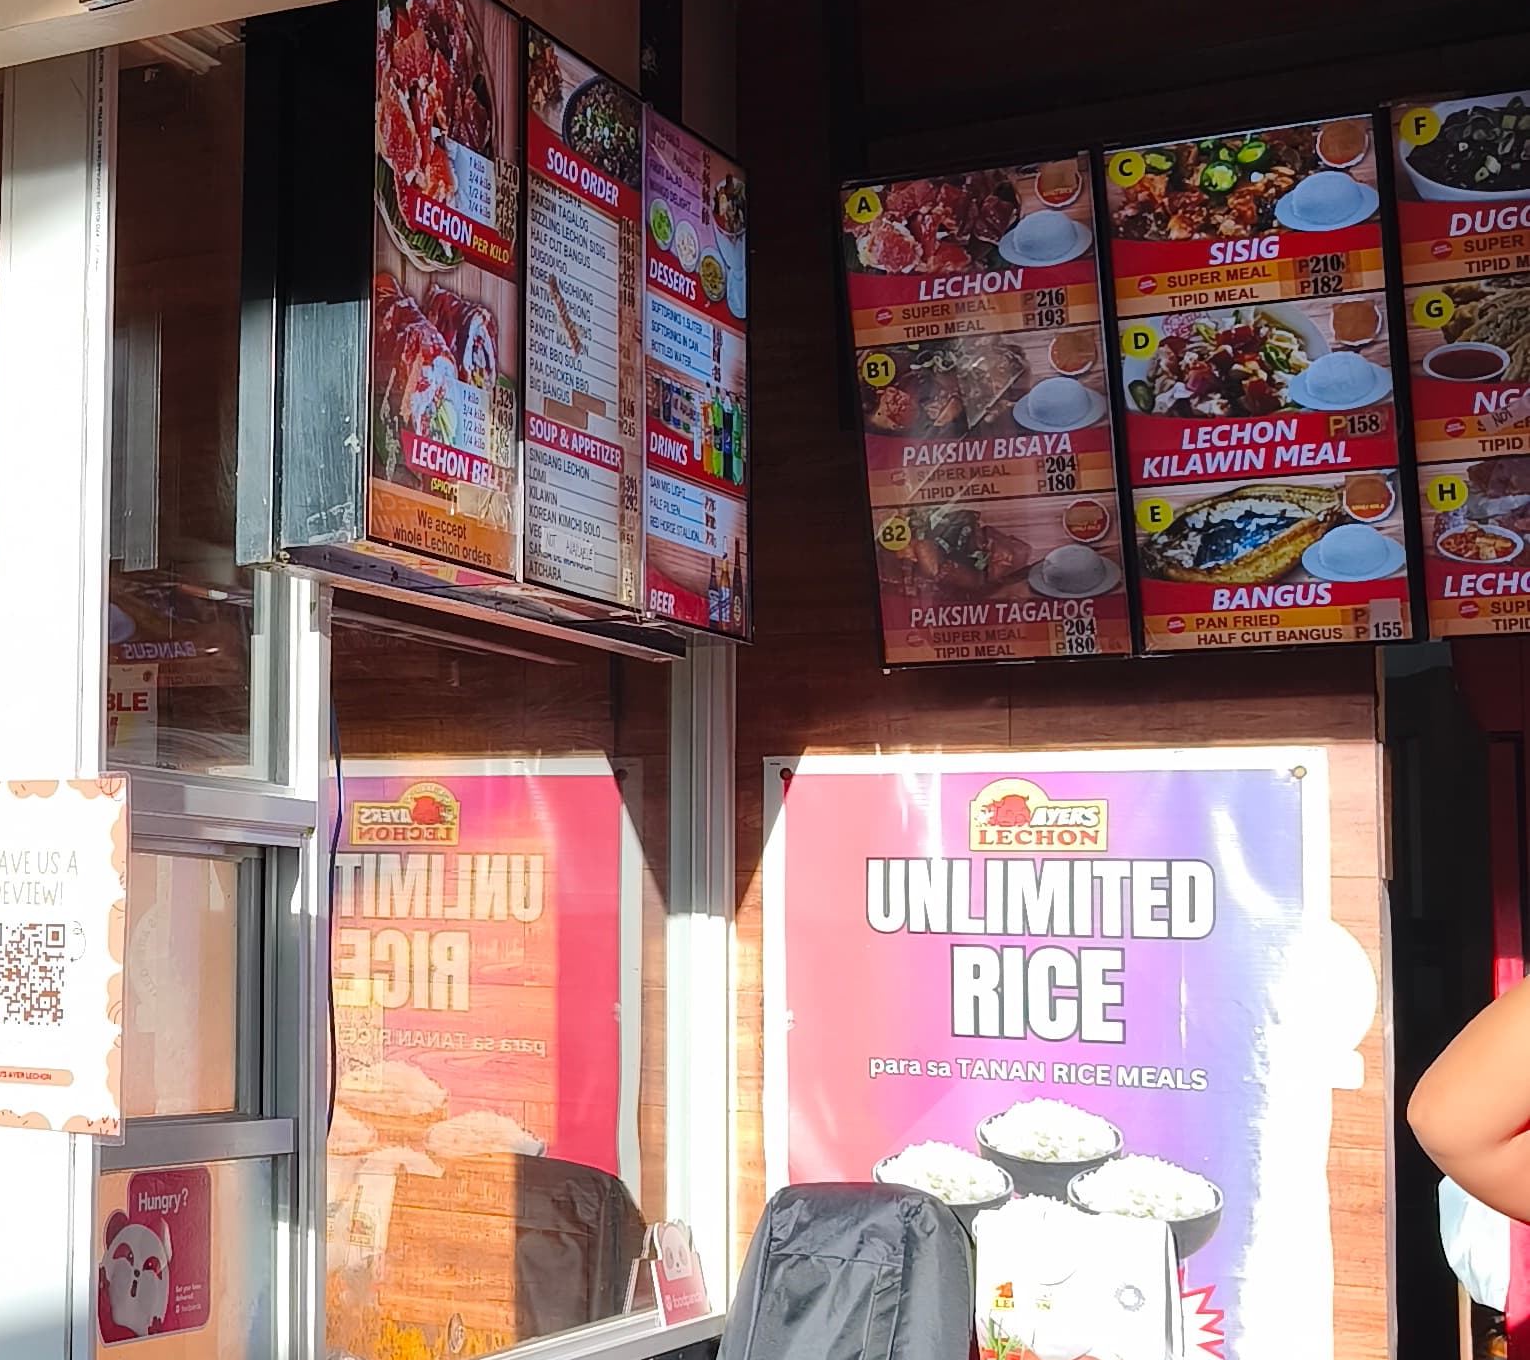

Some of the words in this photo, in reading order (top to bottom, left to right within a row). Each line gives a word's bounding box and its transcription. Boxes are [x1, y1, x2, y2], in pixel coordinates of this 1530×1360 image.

[1414, 117, 1427, 136] F
[547, 147, 579, 183] SOLO
[581, 167, 619, 207] ORDER
[1119, 158, 1132, 176] C
[857, 197, 872, 213] A
[415, 197, 472, 247] LECHON
[472, 234, 488, 255] PER
[490, 243, 510, 264] KILO
[531, 208, 561, 231] SIZZLING
[561, 224, 588, 249] LECHON
[589, 240, 606, 259] SISIG
[530, 226, 548, 245] HALF
[549, 237, 562, 253] CUT
[563, 243, 591, 268] BANGUS
[1209, 236, 1280, 265] SISIG
[1464, 234, 1524, 253] SUPER
[1167, 270, 1221, 288] SUPER
[1226, 266, 1272, 282] MEAL
[1465, 258, 1510, 274] TIPID
[650, 258, 697, 300] DESSERTS
[919, 269, 1024, 301] LECHON
[1168, 293, 1209, 308] TIPID
[1214, 287, 1259, 303] MEAL
[902, 303, 950, 320] SUPER
[954, 298, 996, 314] MEAL
[1425, 300, 1444, 319] G
[904, 323, 940, 338] TIPID
[945, 319, 985, 334] MEAL
[1133, 332, 1150, 350] D
[545, 363, 574, 387] CHICKEN
[867, 361, 889, 378] B1
[468, 392, 479, 404] kilo
[492, 387, 514, 409] 1,329
[530, 376, 541, 391] BIG
[543, 381, 570, 403] BANGUS
[463, 405, 473, 419] 3/4
[474, 409, 485, 421] kilo
[463, 420, 473, 432] 1/2
[474, 423, 485, 436] kilo
[1182, 418, 1298, 450] LECHON
[463, 434, 472, 446] 1/4
[474, 437, 485, 449] kilo
[530, 417, 558, 442] SOUP
[560, 428, 569, 449] &
[571, 433, 621, 467] APPETIZER
[650, 433, 687, 465] DRINKS
[903, 440, 987, 466] PAKSIW
[993, 433, 1072, 459] BISAYA
[1478, 438, 1523, 452] TIPID
[412, 439, 470, 480] LECHON
[529, 448, 562, 472] SINIGANG
[564, 461, 590, 481] LECHON
[1142, 448, 1266, 479] KILAWIN
[1274, 441, 1352, 469] MEAL
[529, 467, 547, 483] LOMI
[918, 467, 966, 481] SUPER
[970, 464, 1010, 478] MEAL
[529, 486, 558, 506] KILAWIN
[920, 487, 955, 500] TIPID
[959, 483, 999, 496] MEAL
[1438, 483, 1456, 501] H
[417, 509, 433, 529] We
[435, 518, 467, 540] accept
[529, 504, 556, 523] KOREAN
[558, 512, 582, 532] KIMCHI
[583, 520, 601, 538] SOLO
[1150, 505, 1162, 523] E
[881, 525, 907, 541] B2
[392, 525, 422, 545] whole
[424, 534, 460, 555] Lechon
[462, 546, 492, 565] orders
[529, 561, 562, 582] ATCHARA
[650, 589, 675, 615] BEER
[1212, 582, 1332, 611] BANGUS
[910, 604, 989, 627] PAKSIW
[995, 599, 1094, 623] TAGALOG
[1195, 616, 1228, 629] PAN
[1233, 614, 1280, 628] FRIED
[933, 631, 983, 644] SUPER
[986, 629, 1027, 641] MEAL
[1197, 632, 1236, 646] HALF
[1241, 630, 1273, 644] CUT
[1276, 628, 1343, 642] BANGUS
[934, 646, 970, 659] TIPID
[975, 644, 1015, 657] MEAL
[1030, 806, 1100, 828] AYERS
[978, 829, 1100, 846] LECHON
[37, 850, 60, 874] US
[67, 850, 78, 876] A
[866, 858, 1215, 939] UNLIMITED
[950, 944, 1126, 1043] RICE
[869, 1056, 923, 1078] para
[926, 1059, 952, 1077] sa
[956, 1058, 1045, 1083] TANAN
[1052, 1063, 1111, 1085] RICE
[1116, 1066, 1209, 1091] MEALS
[138, 1187, 188, 1214] Hungry?
